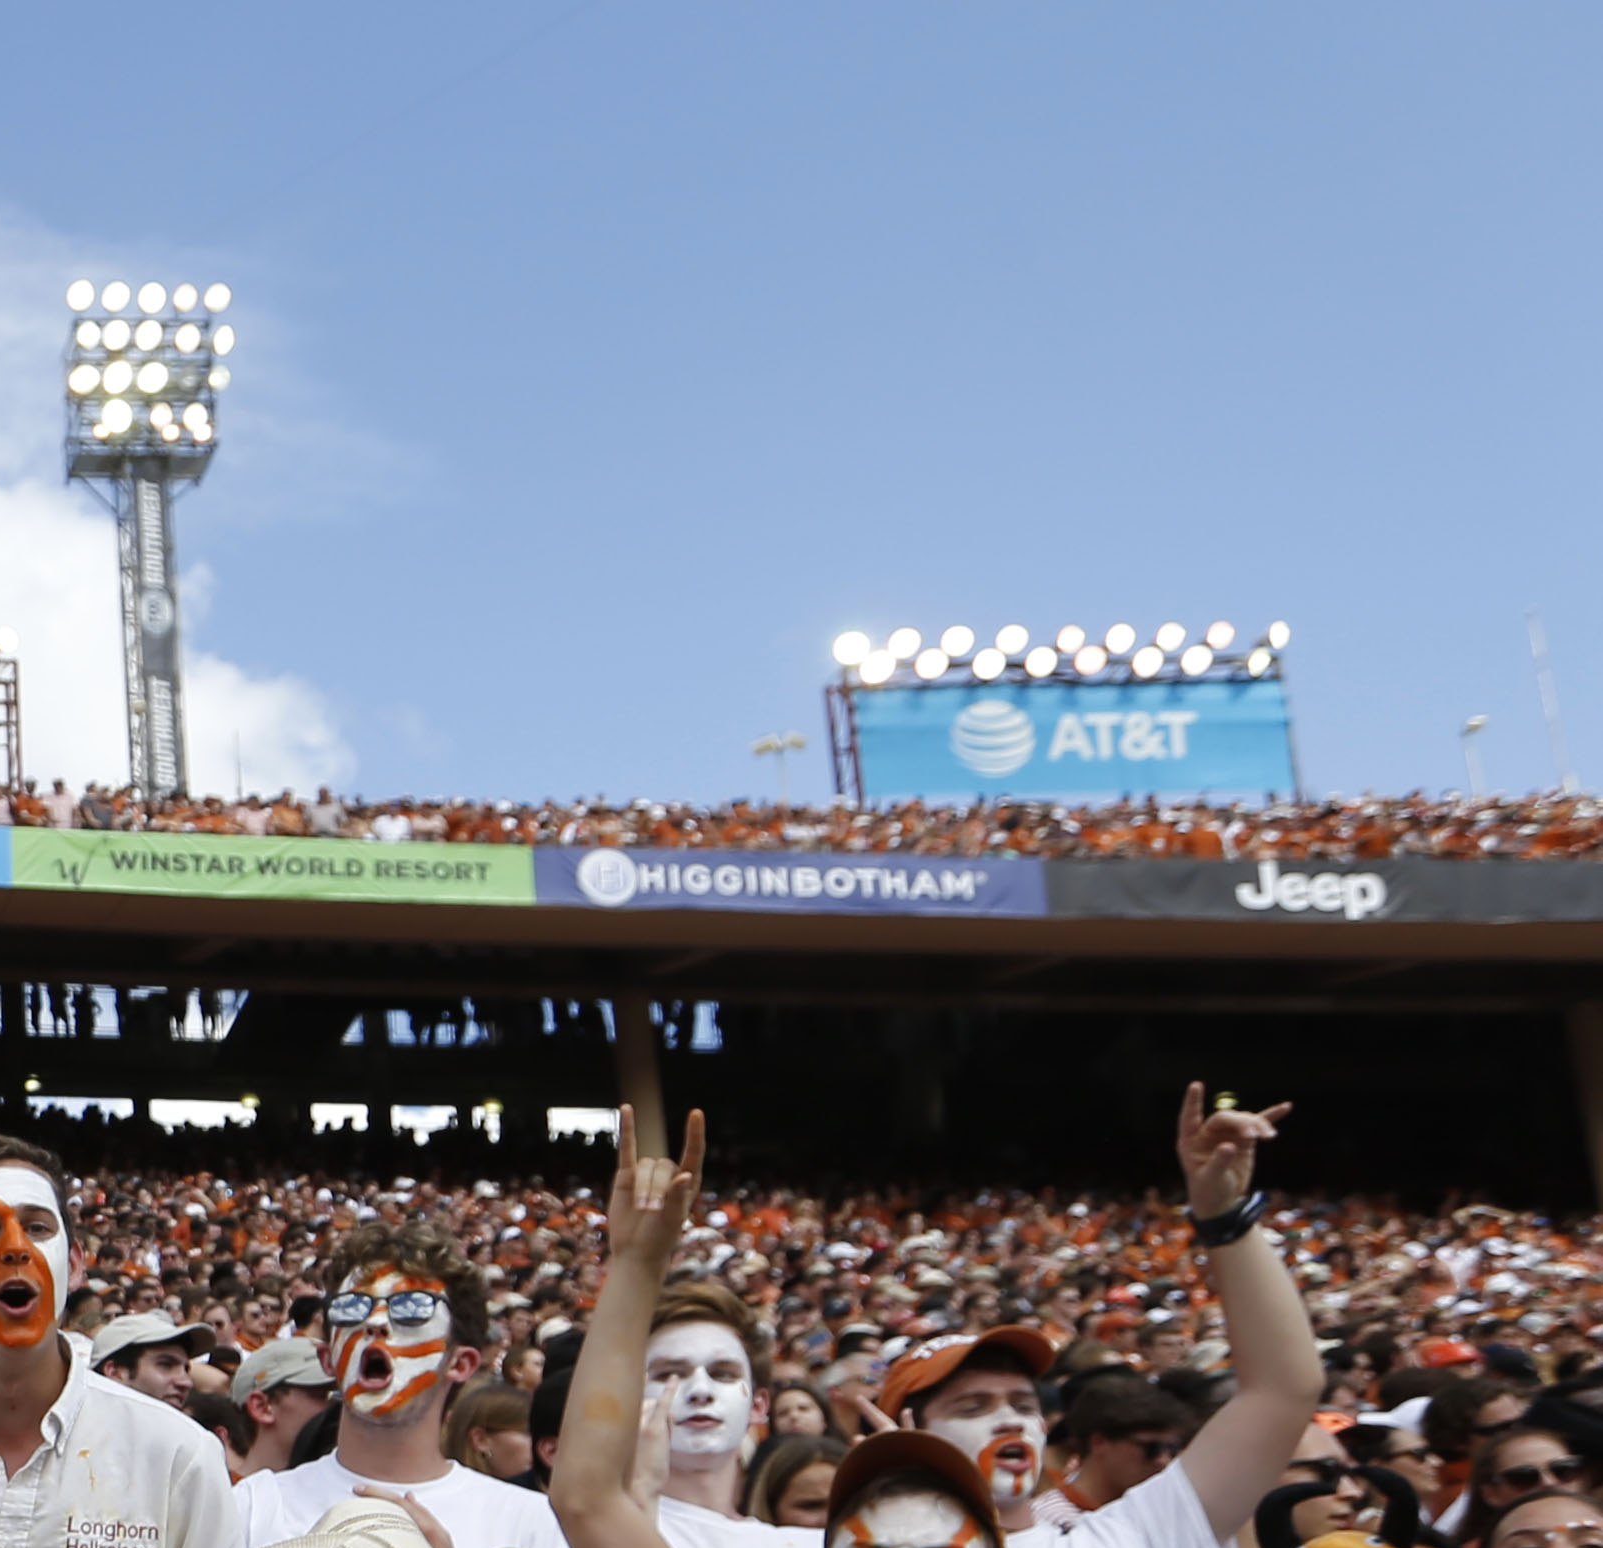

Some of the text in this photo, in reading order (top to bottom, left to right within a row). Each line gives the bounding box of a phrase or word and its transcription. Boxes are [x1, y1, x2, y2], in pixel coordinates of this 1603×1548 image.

[1046, 711, 1196, 761] AT&T
[110, 850, 491, 882] WINSTAR WORLD RESORT
[639, 863, 976, 900] HIGGINBOTHAM
[1235, 860, 1387, 920] Jeep
[67, 1516, 159, 1541] Longhorn
